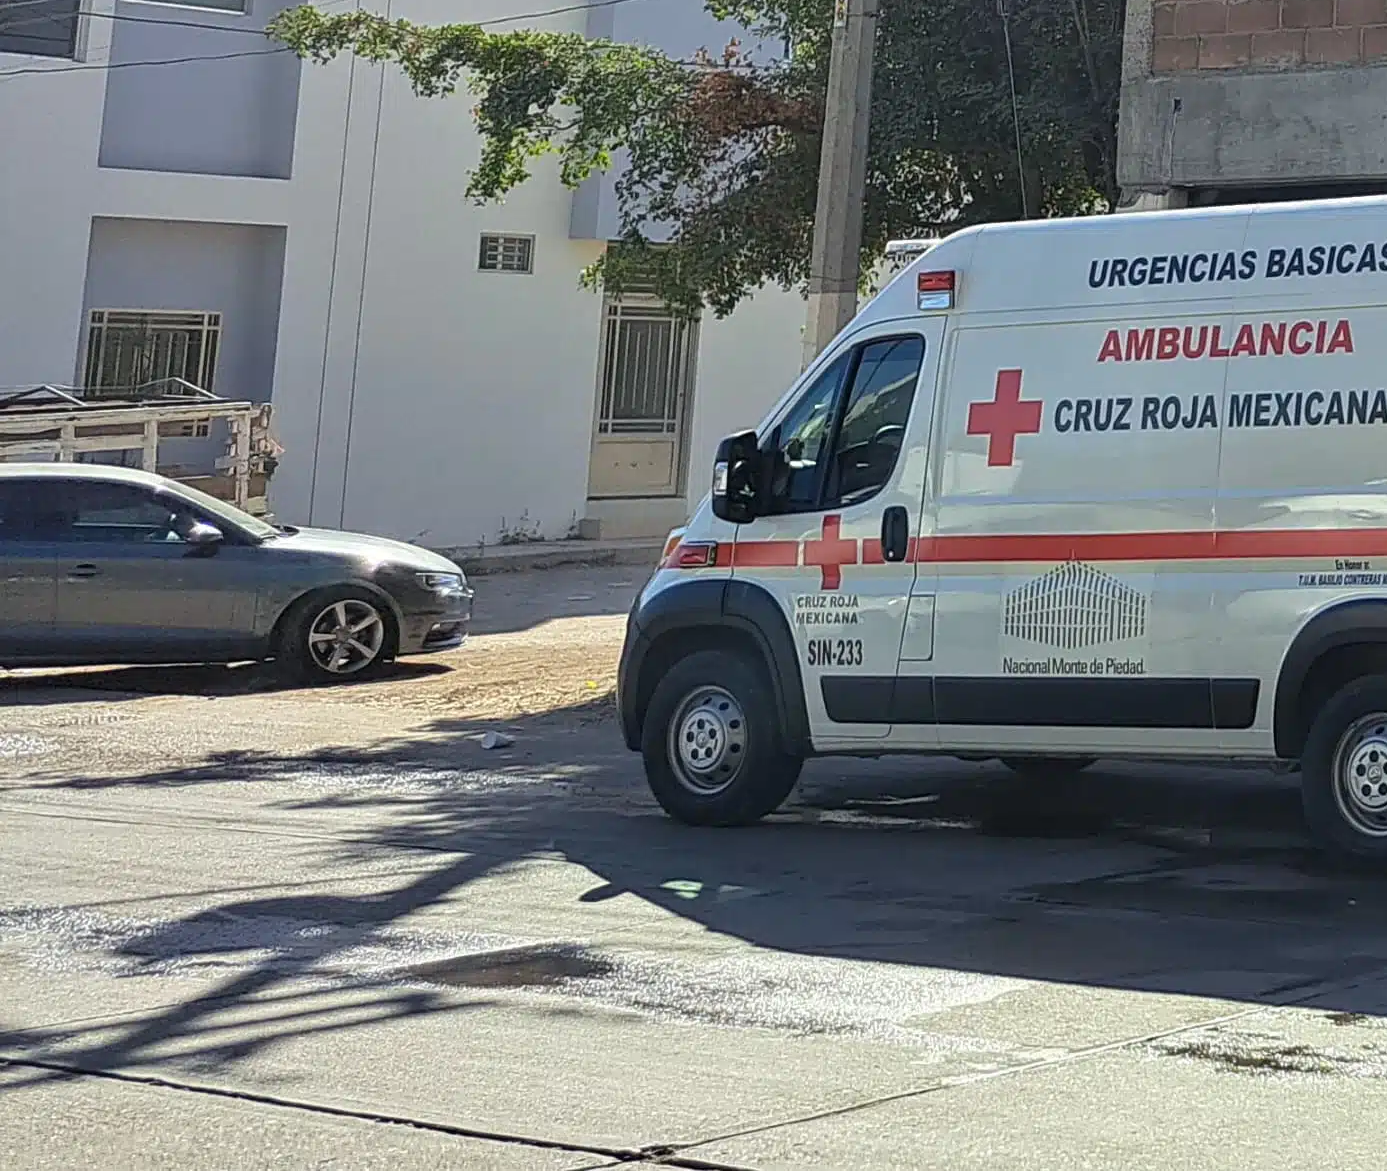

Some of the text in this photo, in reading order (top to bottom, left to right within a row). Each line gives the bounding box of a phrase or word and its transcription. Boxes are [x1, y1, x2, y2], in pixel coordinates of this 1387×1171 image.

[1088, 249, 1258, 289] URGENCIAS
[1097, 319, 1354, 362] AMBULANCIA
[1054, 396, 1132, 432] CRUZ
[1141, 394, 1218, 430] ROJA
[797, 594, 859, 608] CRUZ ROJA
[796, 611, 858, 625] MEXICANA
[807, 639, 863, 666] SIN-233
[1003, 657, 1050, 675] Nacional
[1052, 657, 1088, 675] Monte
[1089, 657, 1104, 675] de
